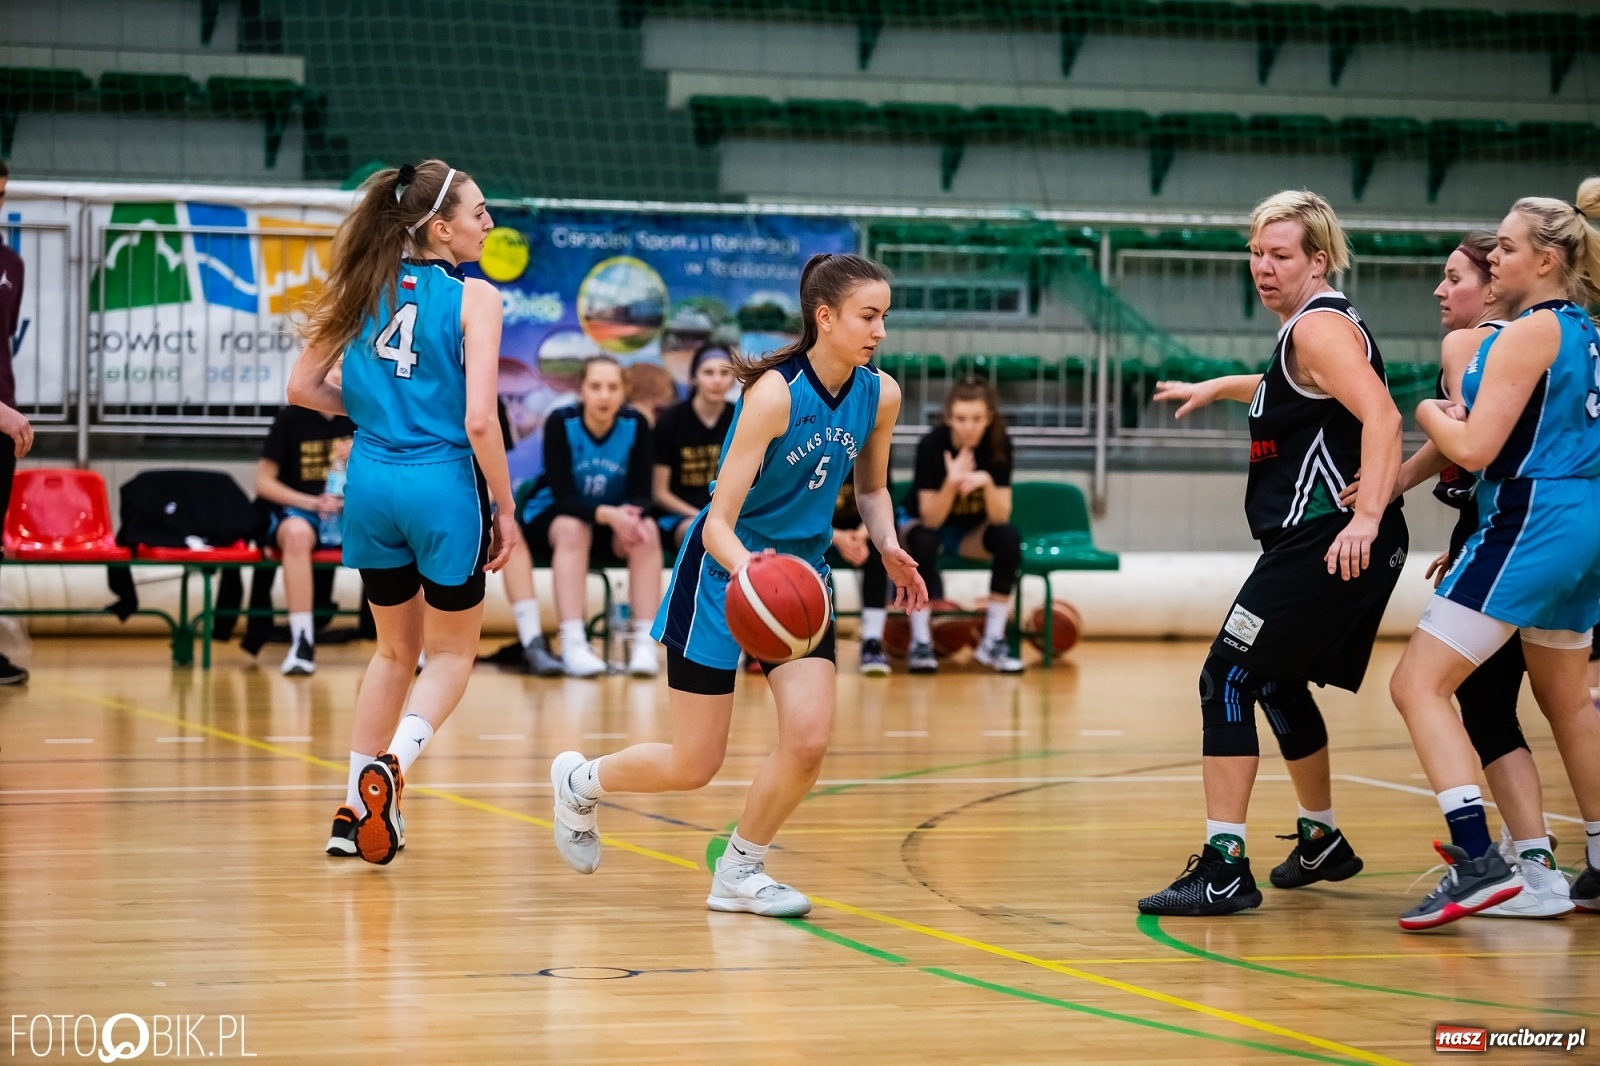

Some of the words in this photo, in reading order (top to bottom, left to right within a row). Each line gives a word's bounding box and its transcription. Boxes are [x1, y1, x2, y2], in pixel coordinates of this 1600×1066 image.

[375, 301, 419, 380] 4
[786, 432, 823, 466] MLKS
[807, 455, 831, 491] 5
[1223, 636, 1249, 653] COLO
